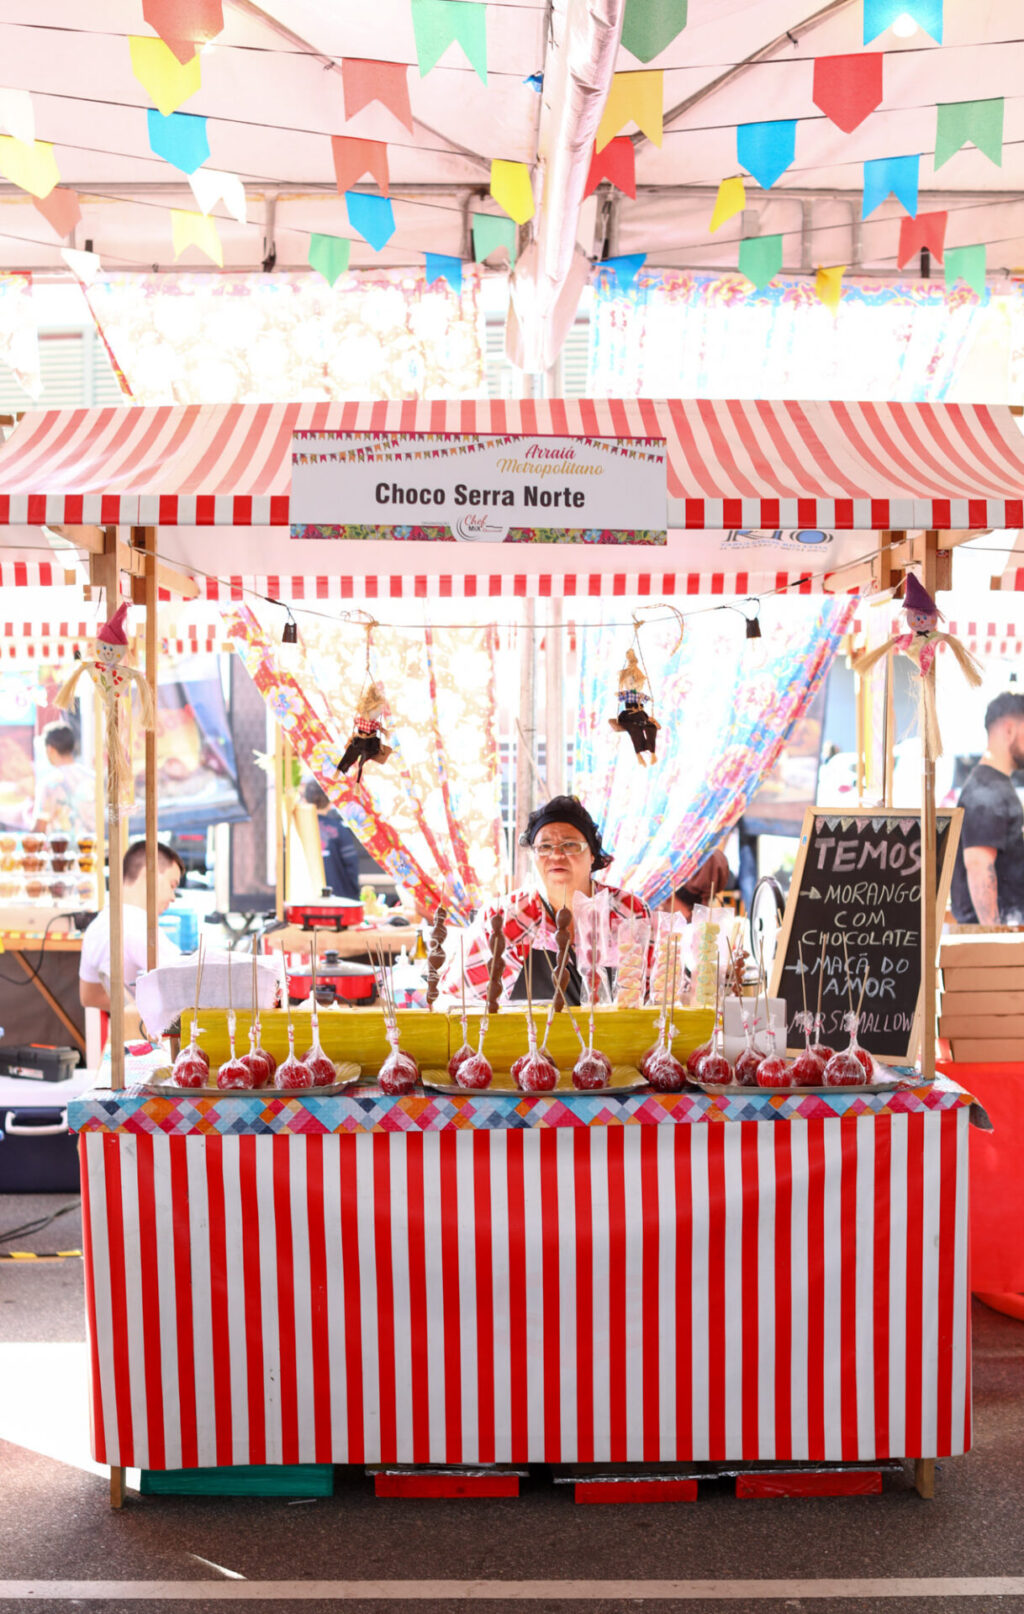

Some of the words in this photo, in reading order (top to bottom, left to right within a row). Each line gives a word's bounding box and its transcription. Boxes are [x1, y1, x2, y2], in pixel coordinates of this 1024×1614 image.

[525, 444, 577, 460] Arraiá
[496, 458, 605, 479] Metropolitano
[375, 482, 446, 506] Choco
[453, 483, 515, 507] Serra
[523, 485, 585, 508] Norte
[464, 513, 488, 528] Chef
[815, 837, 921, 876] TEMOS
[824, 881, 921, 905] MORANGO
[834, 909, 885, 928] COM
[802, 929, 918, 947] CHOCOLATE
[880, 956, 909, 974] DO
[823, 976, 896, 999] AMOR
